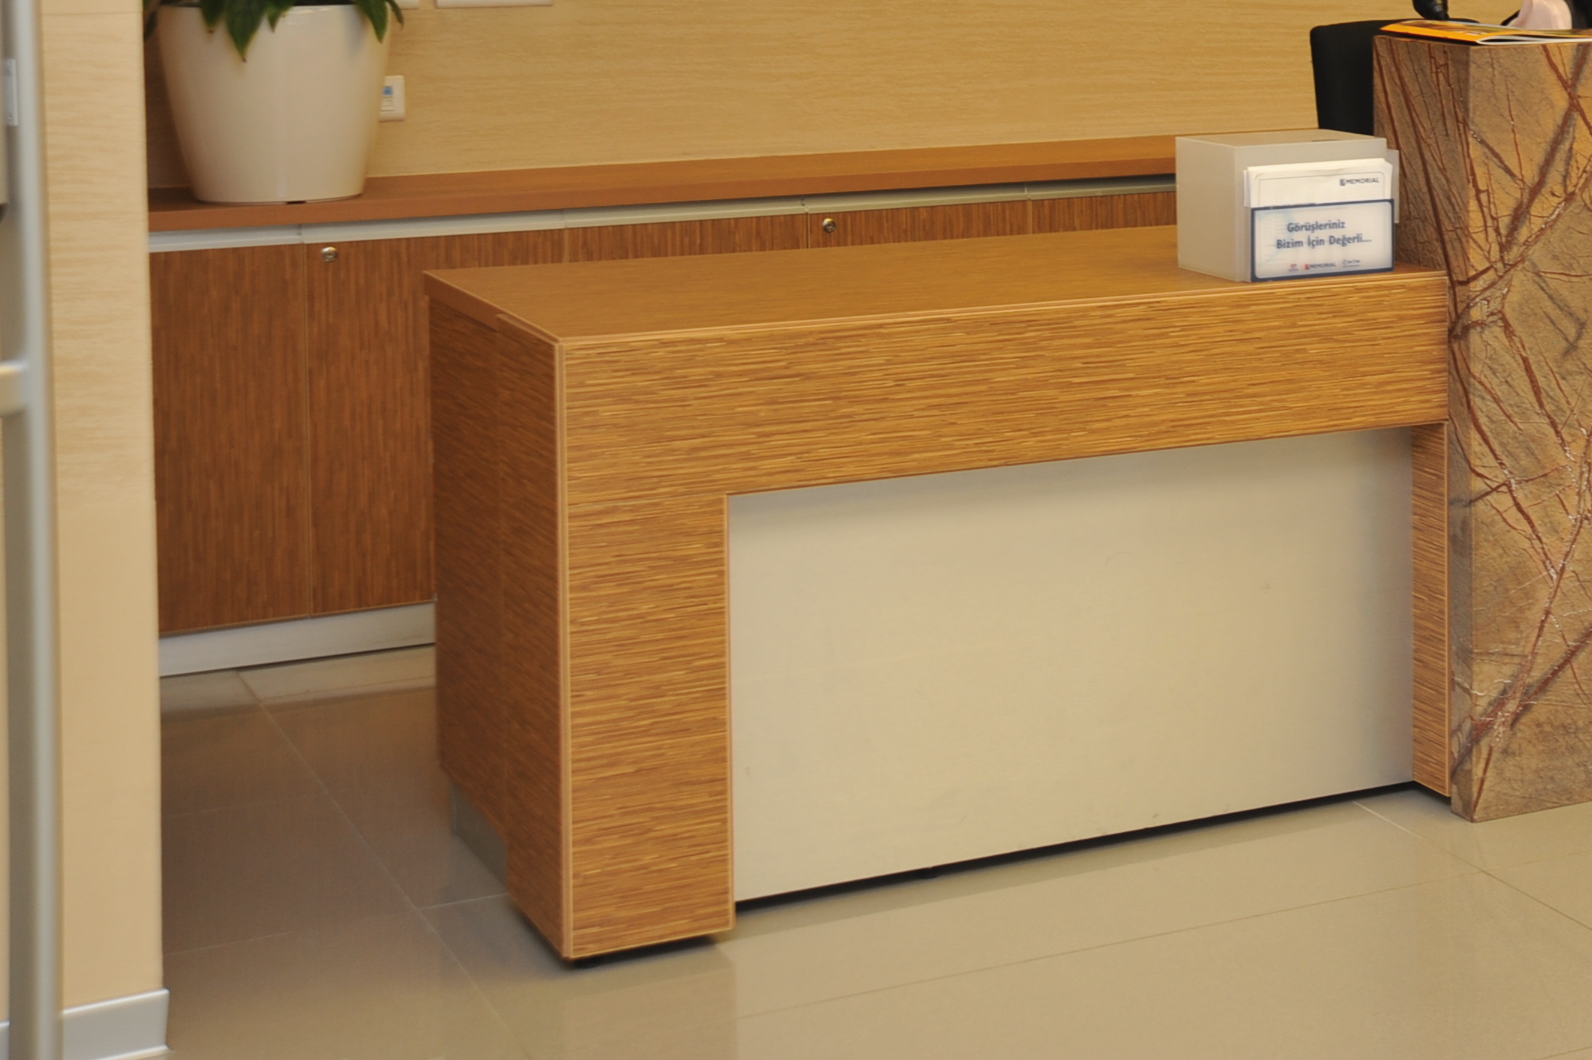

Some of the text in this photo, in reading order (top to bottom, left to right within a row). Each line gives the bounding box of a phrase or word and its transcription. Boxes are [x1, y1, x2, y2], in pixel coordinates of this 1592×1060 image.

[1287, 220, 1346, 233] Görüşleriniz
[1276, 237, 1304, 249] Bizim
[1307, 235, 1325, 249] İçin
